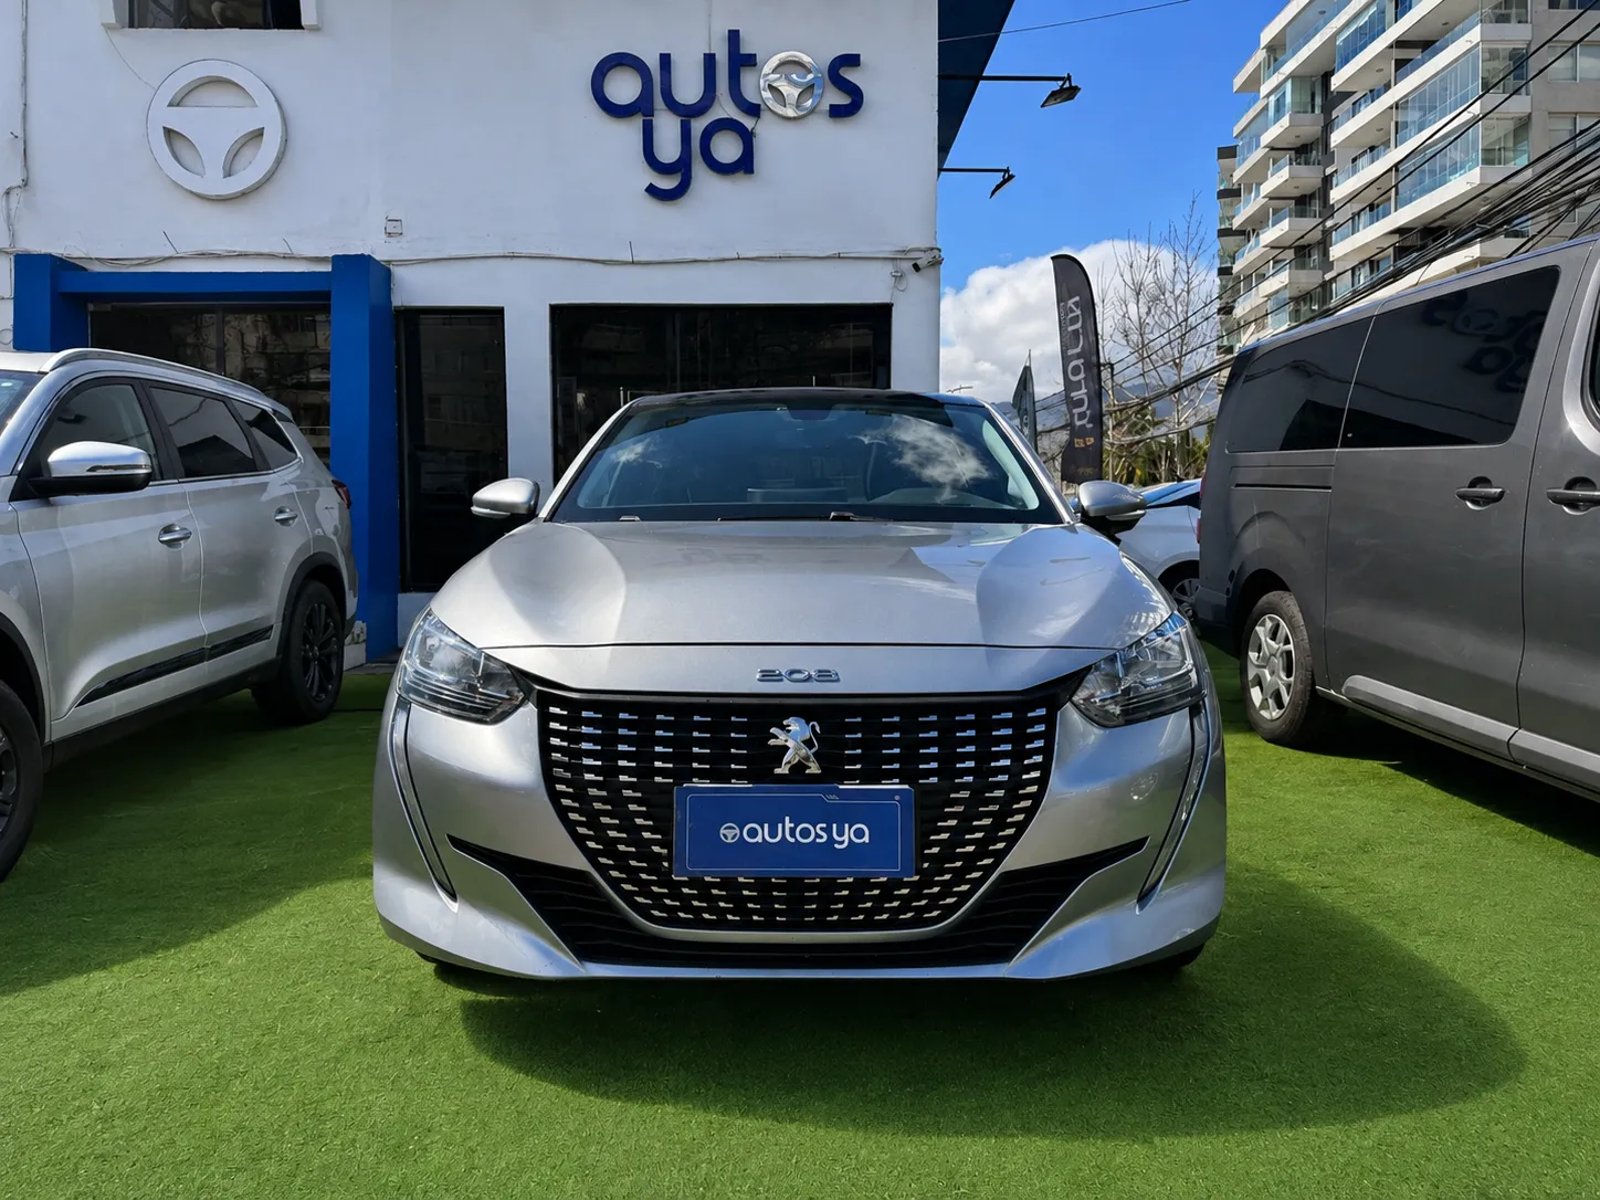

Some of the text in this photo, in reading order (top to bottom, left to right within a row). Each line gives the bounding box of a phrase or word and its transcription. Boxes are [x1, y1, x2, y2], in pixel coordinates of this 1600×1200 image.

[591, 29, 864, 119] autos
[642, 117, 755, 201] ya
[757, 668, 840, 683] 208
[743, 816, 870, 850] autos ya
